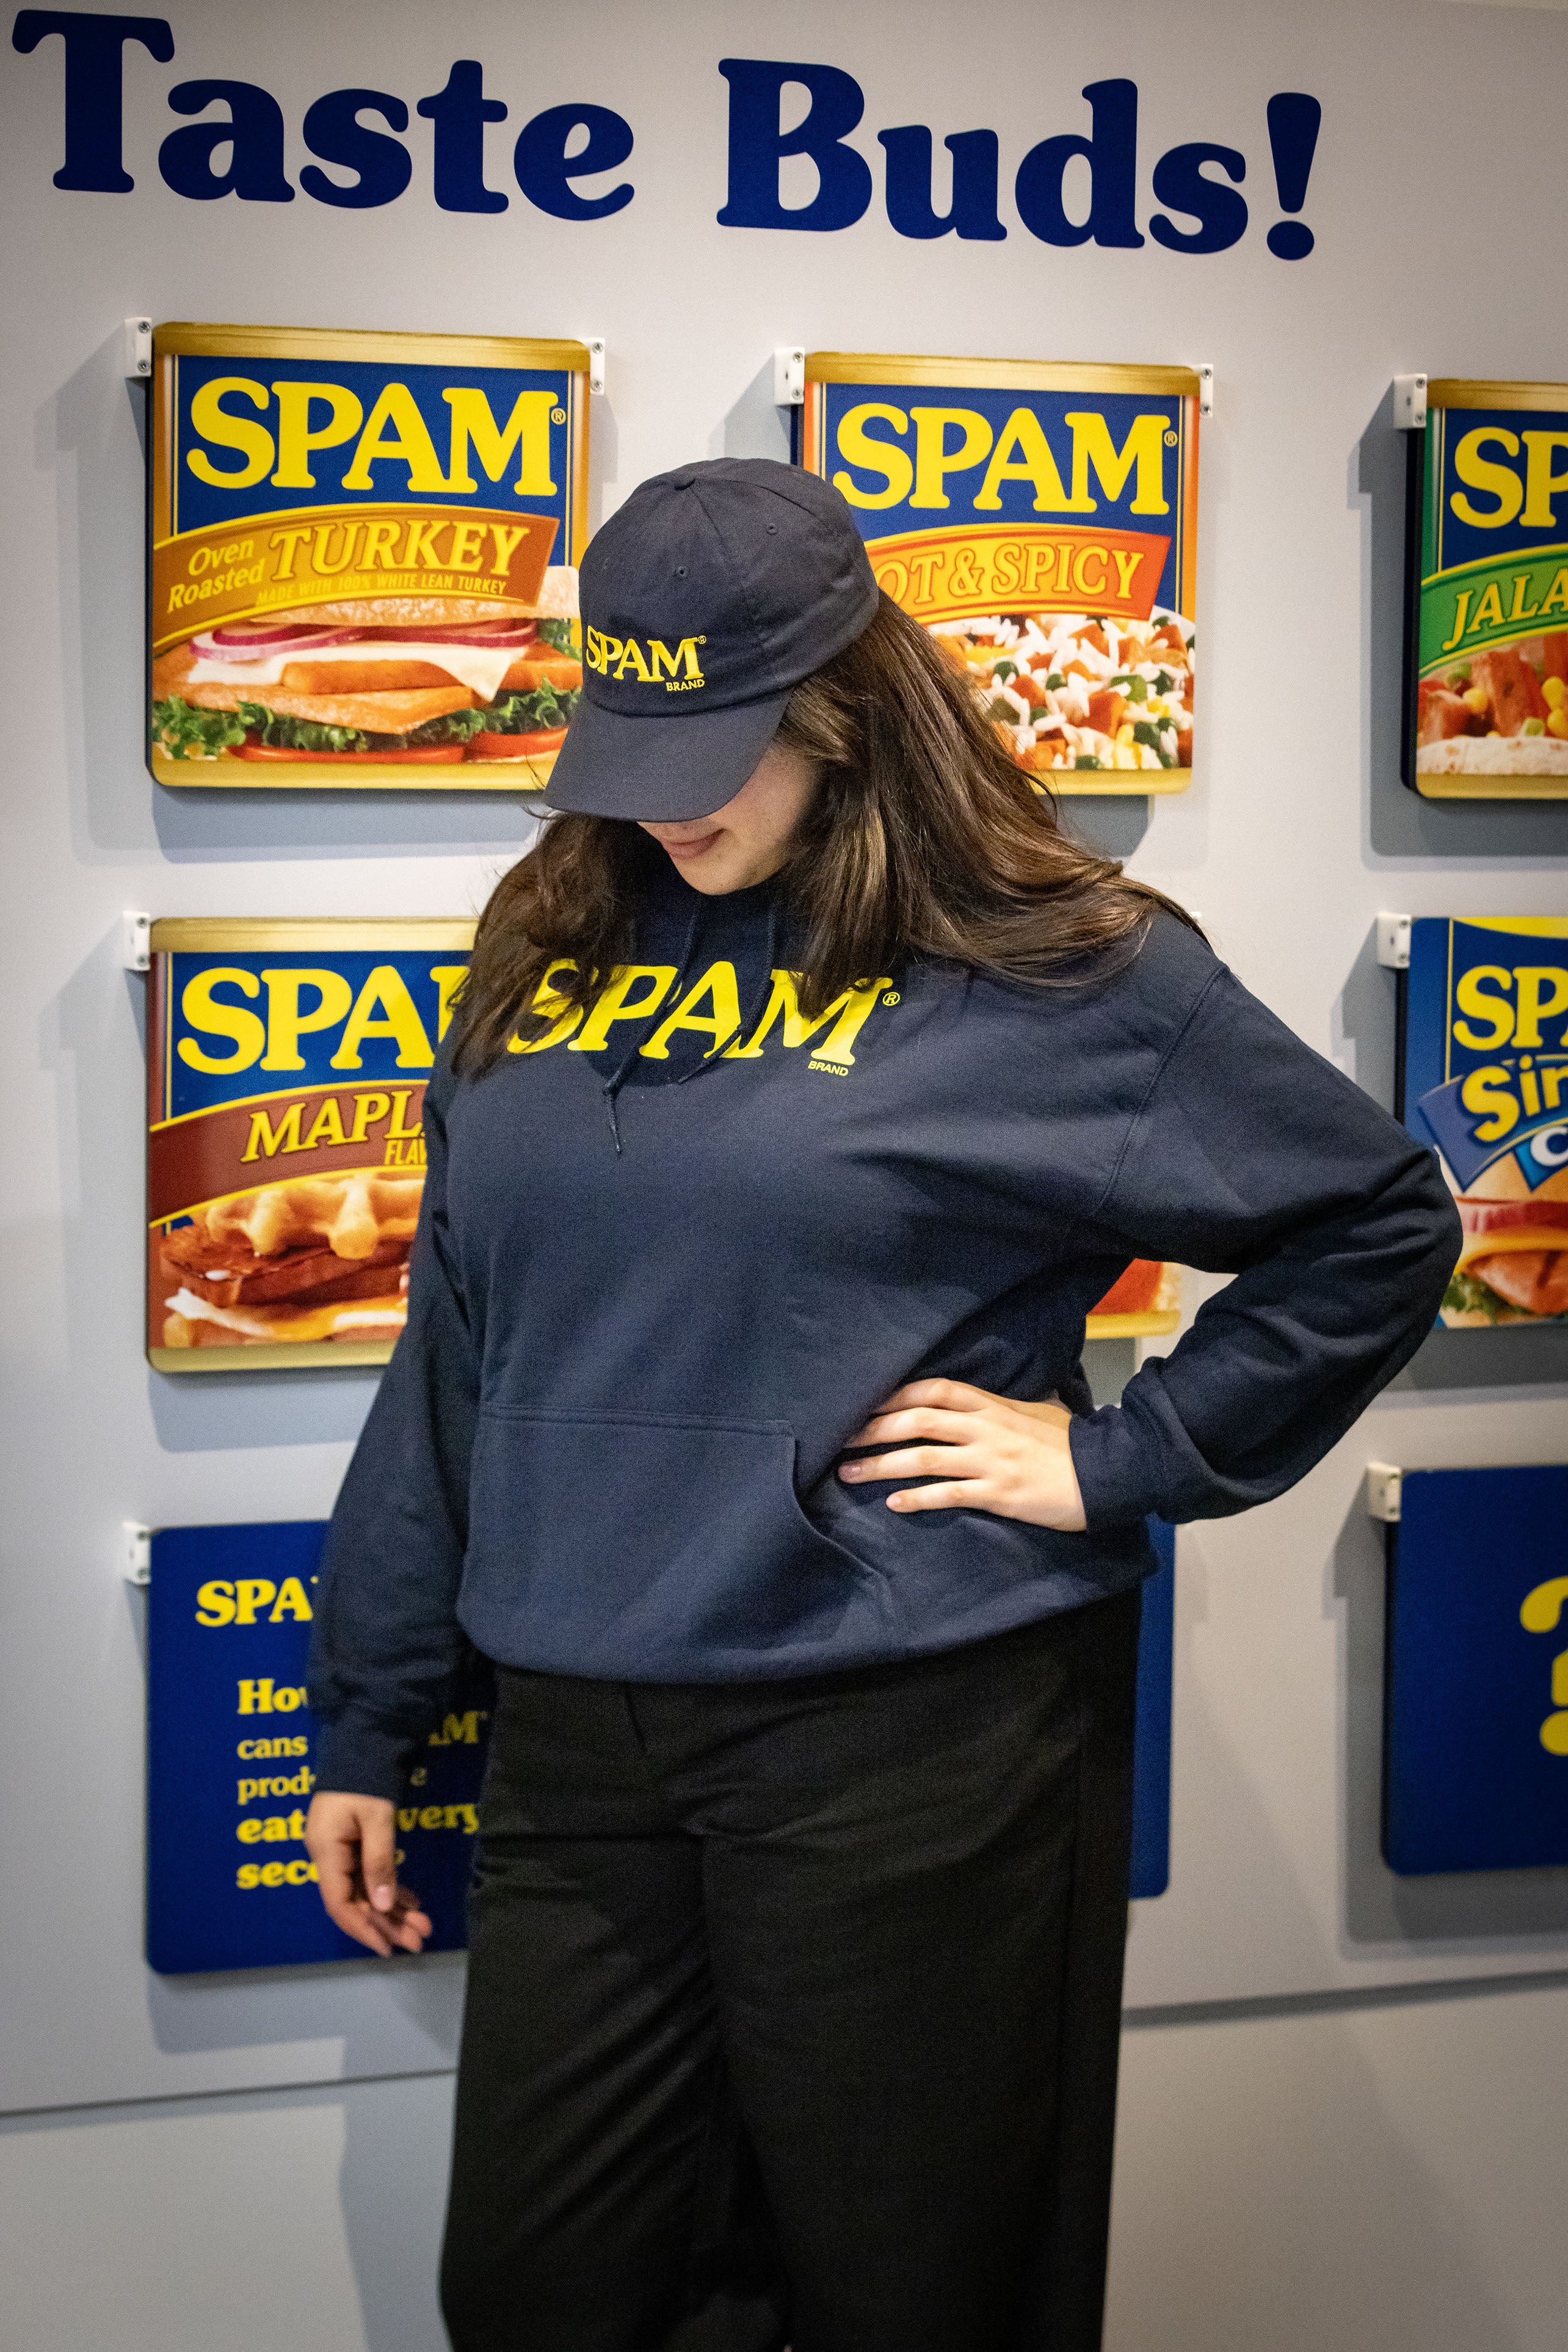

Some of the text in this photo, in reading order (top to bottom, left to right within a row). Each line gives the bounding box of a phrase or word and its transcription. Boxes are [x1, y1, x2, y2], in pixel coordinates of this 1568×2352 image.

[12, 9, 1321, 260] Taste Buds!
[189, 539, 254, 576] Oven
[270, 520, 529, 580] TURKEY
[167, 558, 264, 613] Roasted
[256, 584, 294, 606] MADE
[299, 578, 332, 596] WITH
[377, 573, 418, 588] WHITE
[421, 574, 454, 589] LEAN
[458, 575, 506, 595] TURKEY
[666, 679, 705, 691] BRAND
[1453, 965, 1568, 1050] SP
[807, 1060, 849, 1077] BRAND
[241, 1090, 426, 1162] MAPL
[195, 1575, 319, 1627] SPA
[237, 1678, 307, 1715] Ho
[237, 1736, 308, 1760] cans
[237, 1766, 316, 1806] prod
